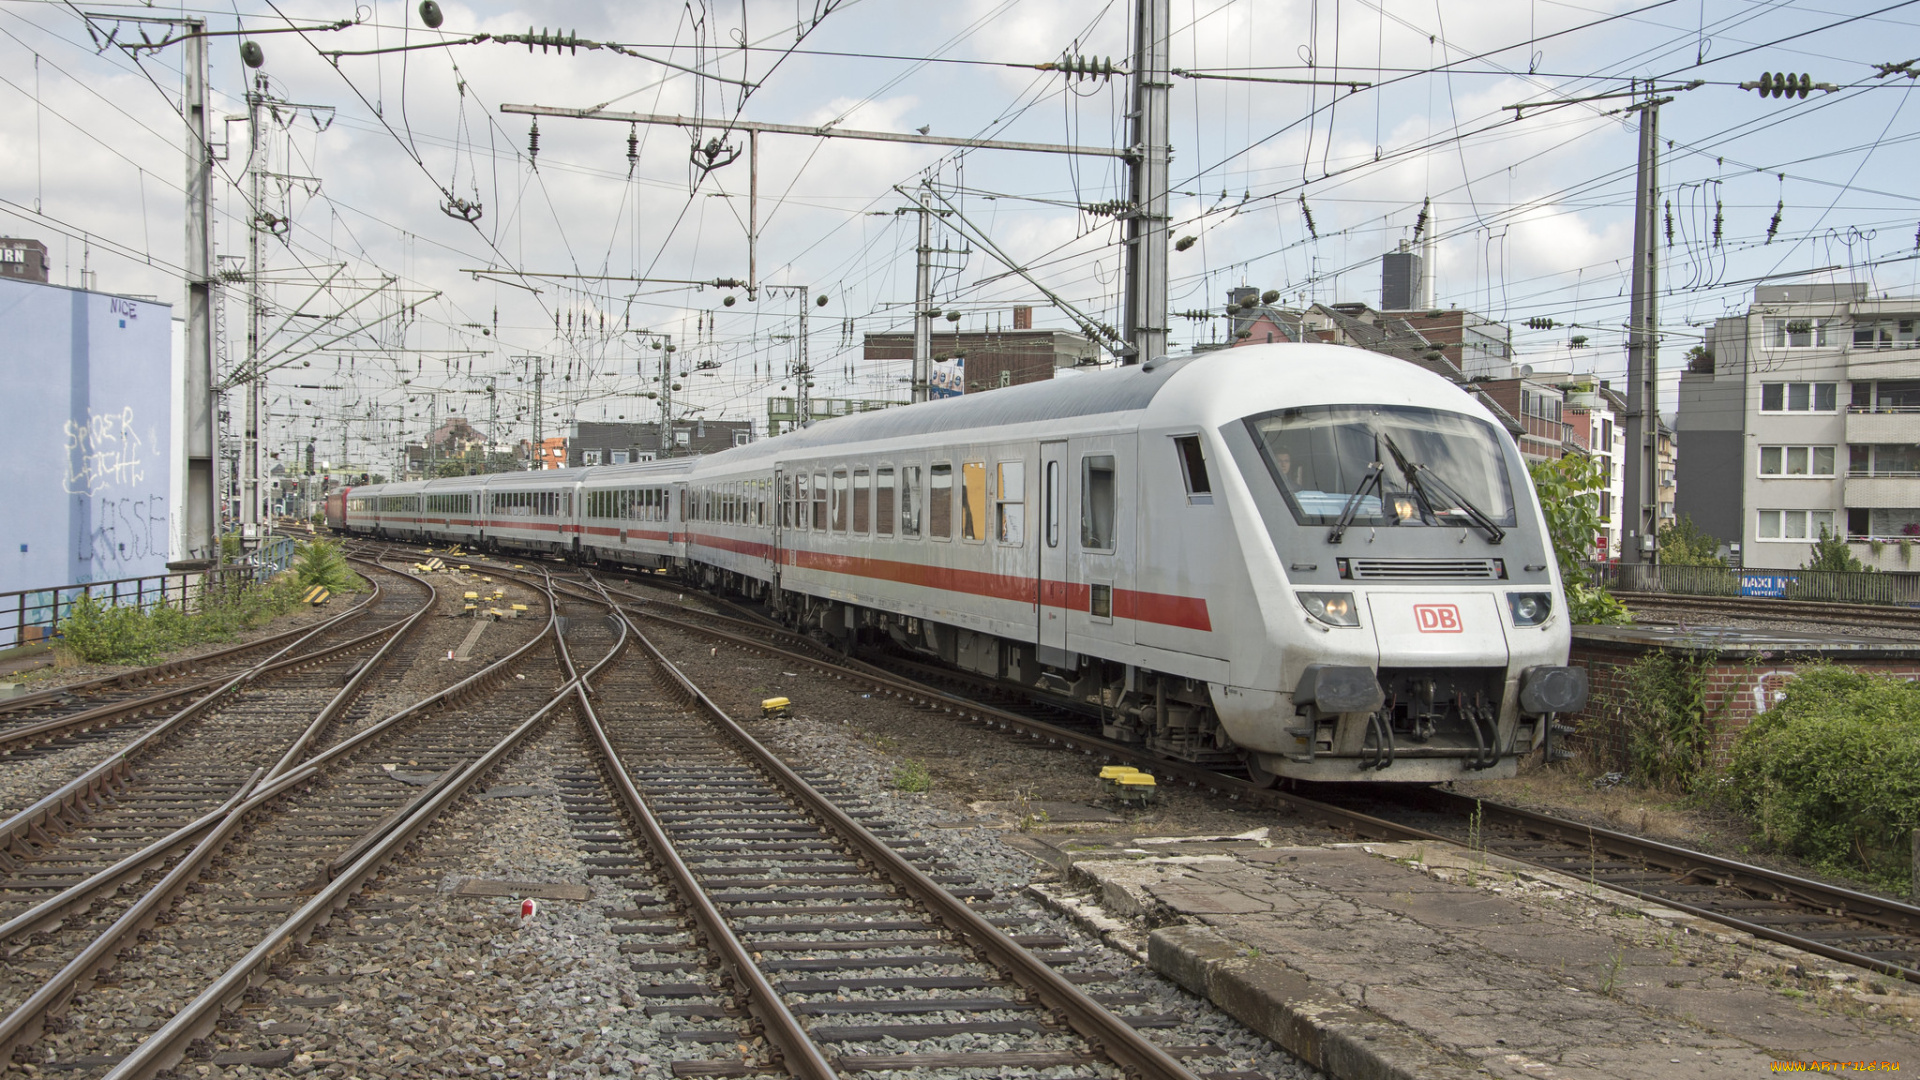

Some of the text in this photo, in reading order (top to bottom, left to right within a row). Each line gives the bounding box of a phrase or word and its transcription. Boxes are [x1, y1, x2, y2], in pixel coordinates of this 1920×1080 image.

[0, 249, 25, 262] RN
[110, 298, 137, 319] NICE
[1420, 608, 1457, 628] DB
